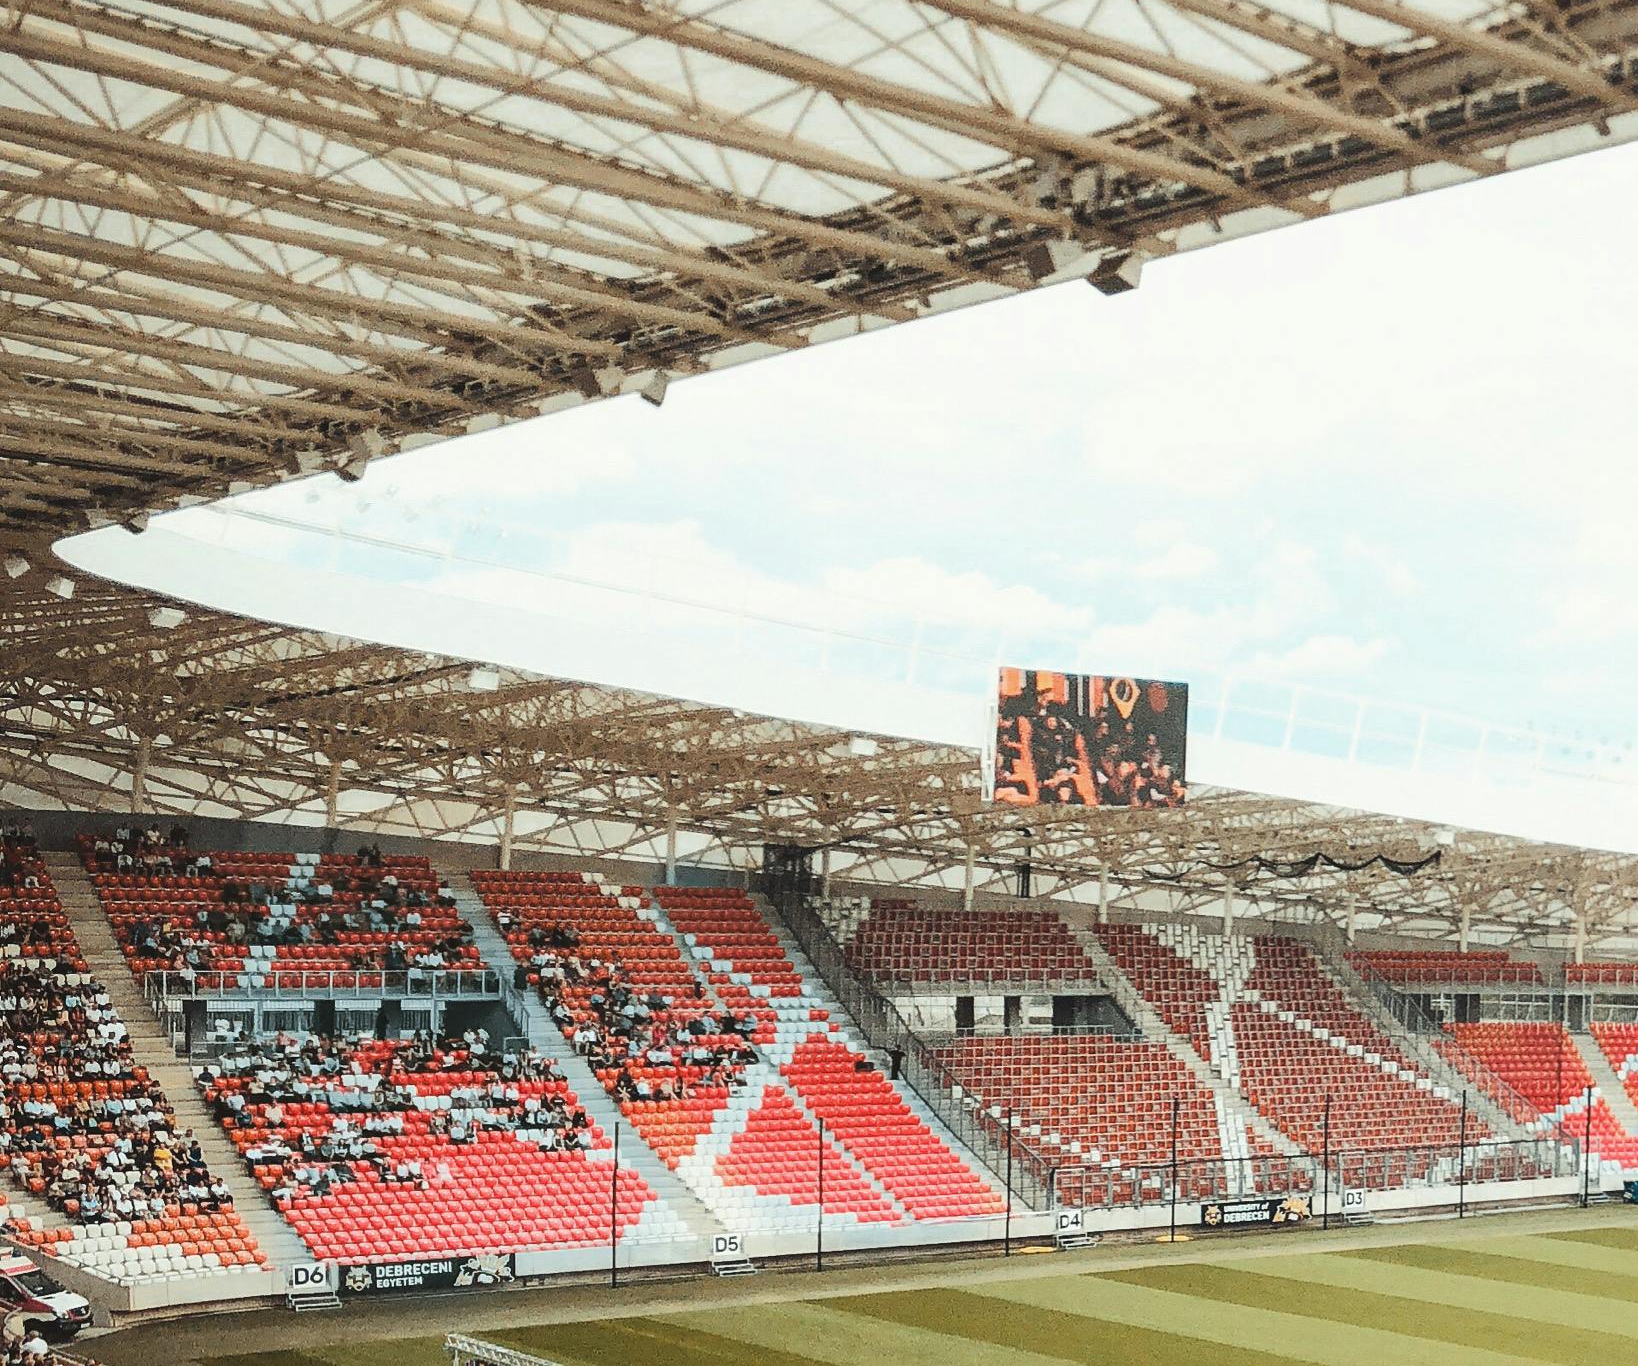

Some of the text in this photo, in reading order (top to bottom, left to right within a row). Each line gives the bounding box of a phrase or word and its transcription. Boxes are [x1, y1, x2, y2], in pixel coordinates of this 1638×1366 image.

[1346, 1191, 1363, 1205] D3
[1059, 1213, 1081, 1229] D4
[1223, 1210, 1270, 1223] DEBRECEN
[715, 1235, 739, 1253] D5
[293, 1266, 324, 1286] D6
[375, 1260, 453, 1278] DEBRECENI
[376, 1276, 423, 1288] EGYETEM
